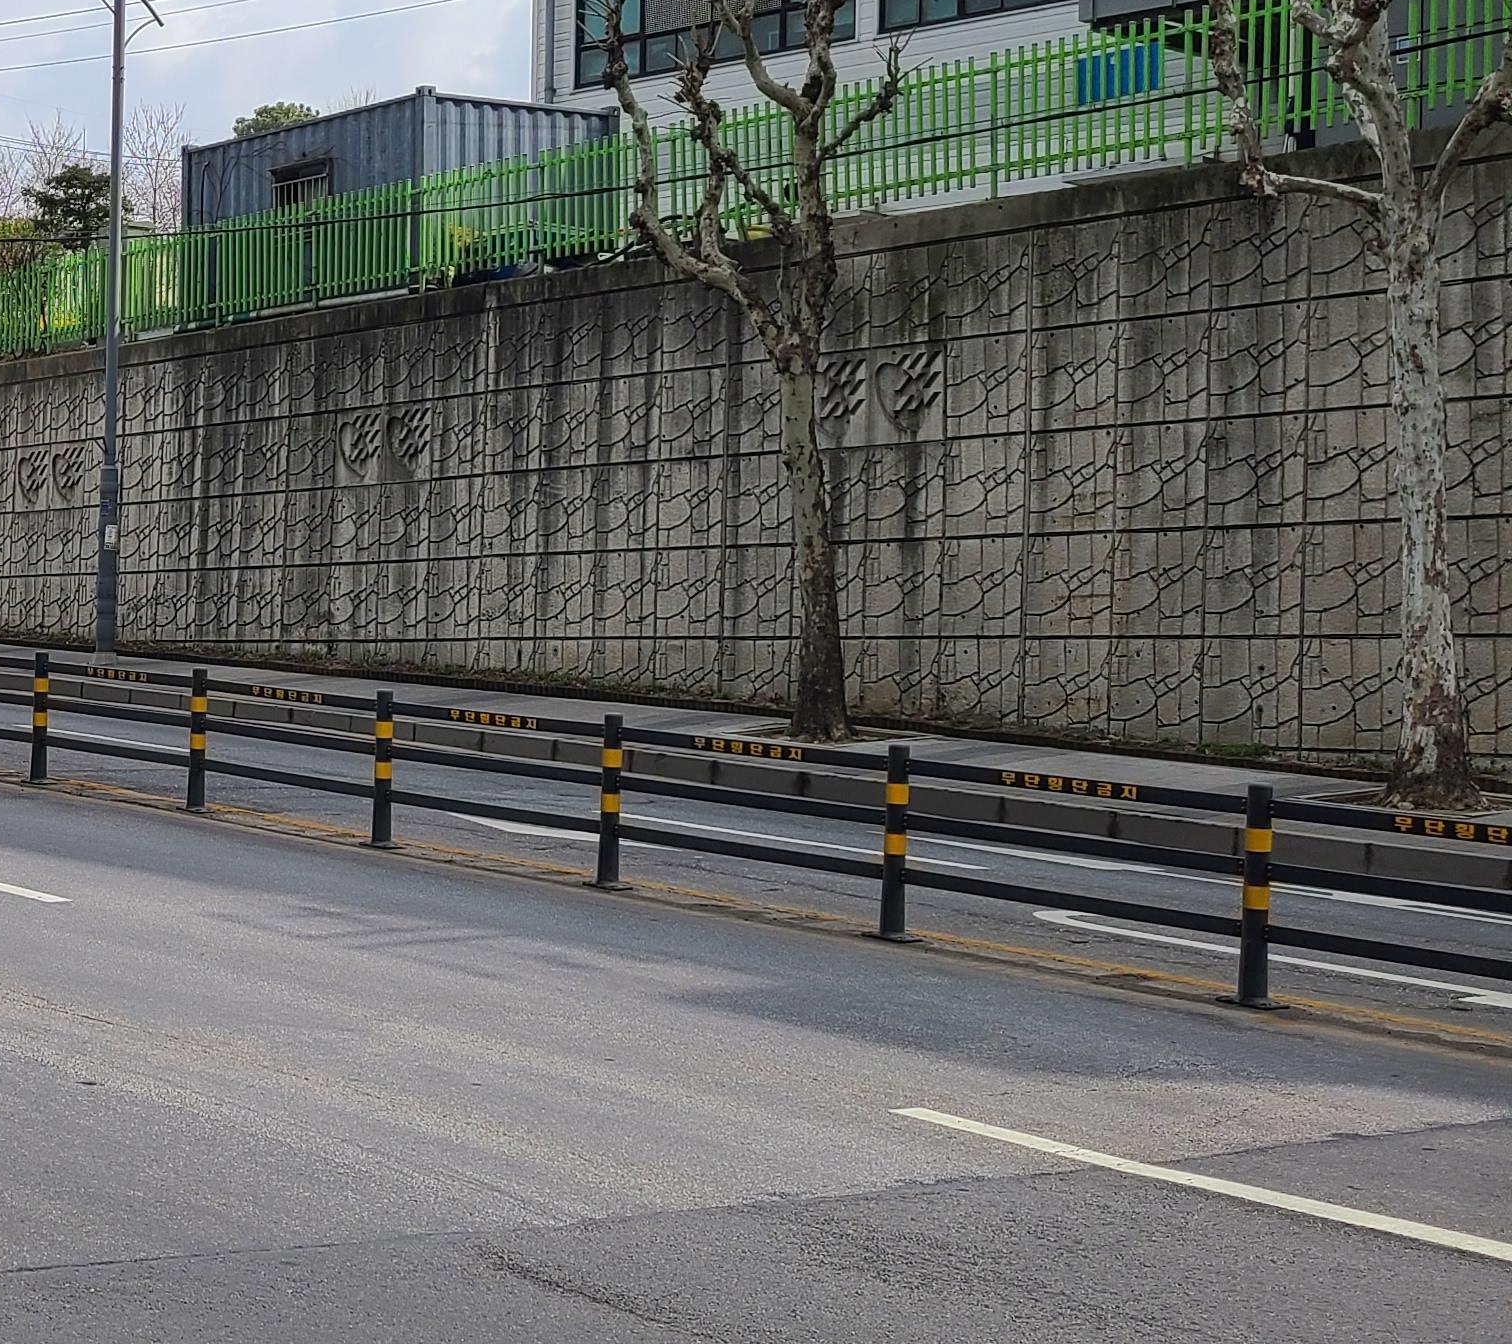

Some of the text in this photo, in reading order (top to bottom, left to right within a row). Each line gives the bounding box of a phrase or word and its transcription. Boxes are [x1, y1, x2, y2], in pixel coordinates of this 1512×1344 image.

[251, 685, 323, 705] 무단횡단금지
[449, 708, 538, 730] 무단횡단금지
[694, 737, 804, 762] 무단횡단금지
[1000, 770, 1139, 802] 무단횡단금지
[1394, 816, 1509, 844] 무단횡단
